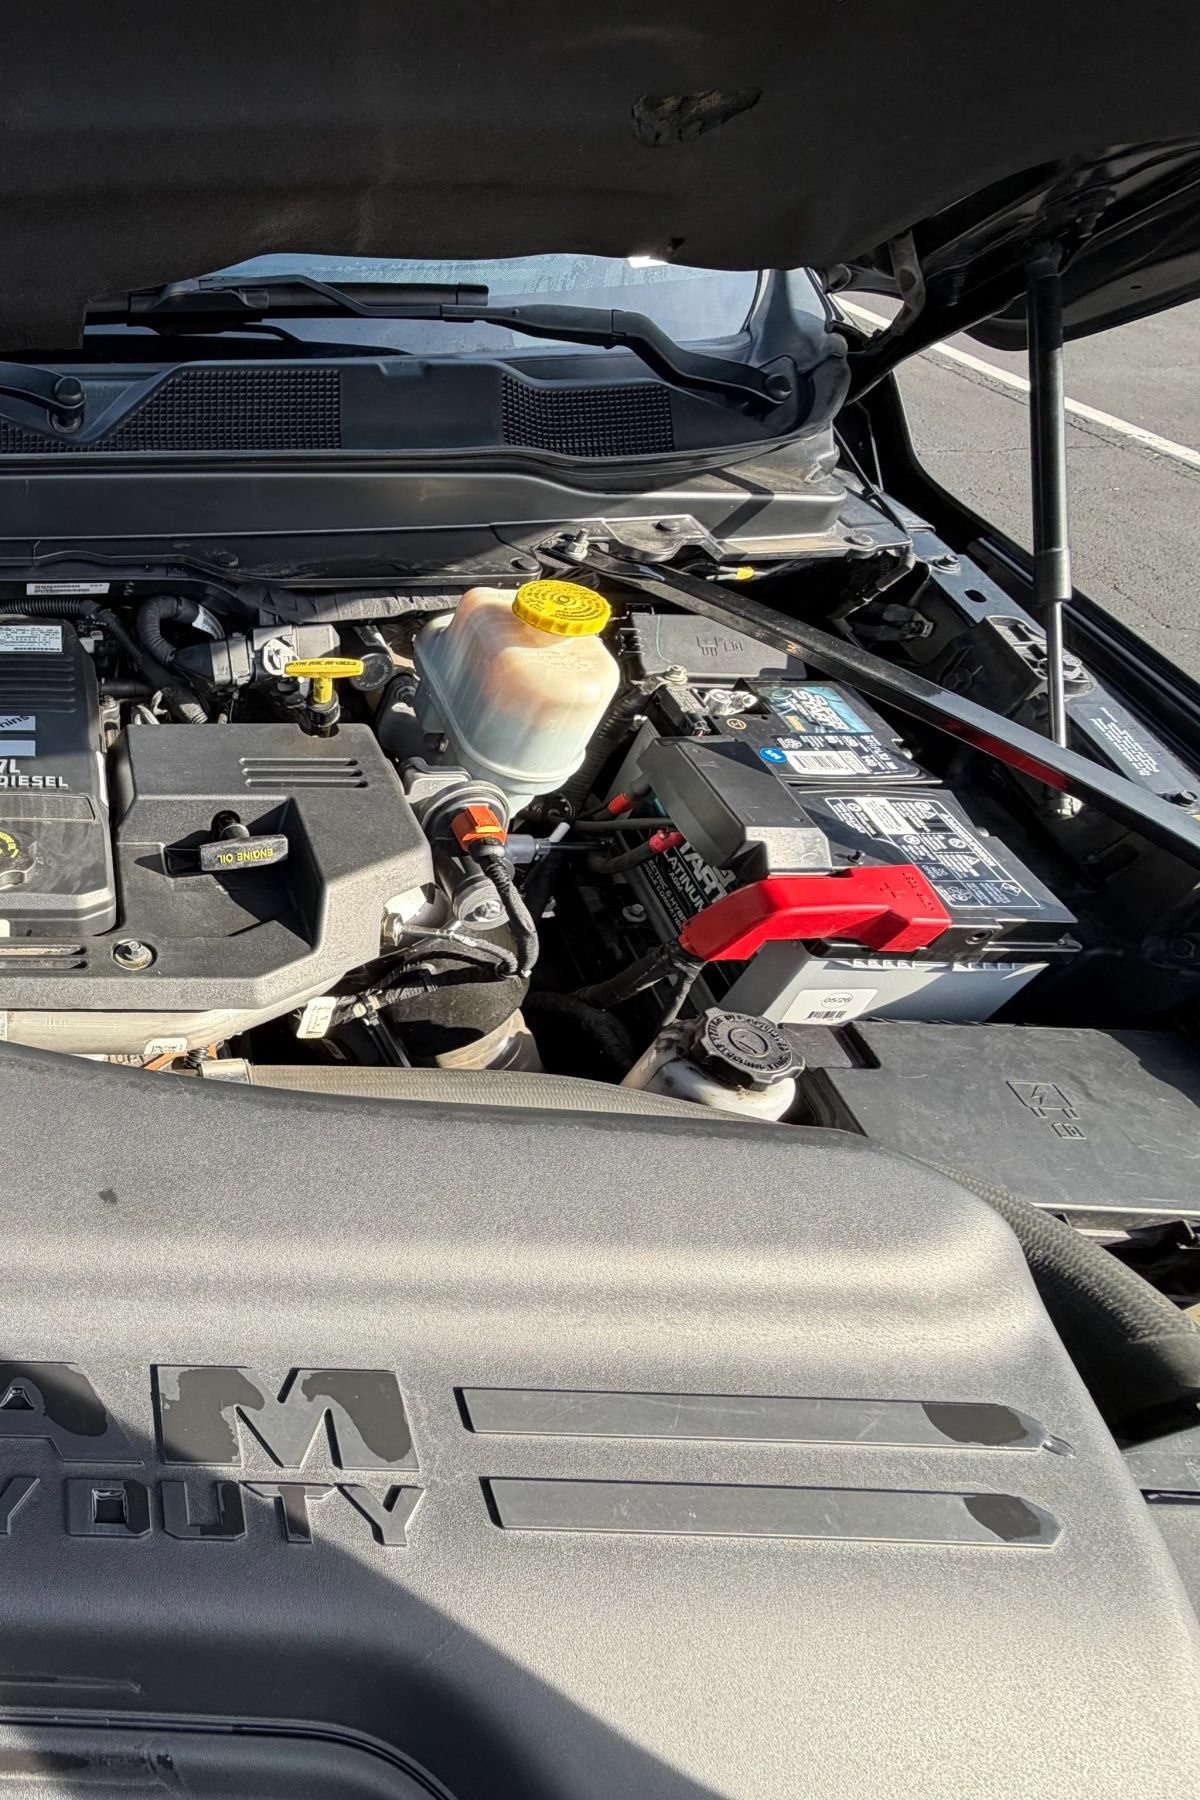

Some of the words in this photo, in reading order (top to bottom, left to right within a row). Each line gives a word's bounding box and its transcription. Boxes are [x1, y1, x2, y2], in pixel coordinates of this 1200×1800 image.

[216, 853, 234, 864] OIL
[237, 848, 274, 862] ENGINE
[647, 859, 669, 891] ECTRIC
[679, 841, 729, 904] TART
[663, 848, 705, 913] LATINUM
[65, 1479, 426, 1547] DUTY
